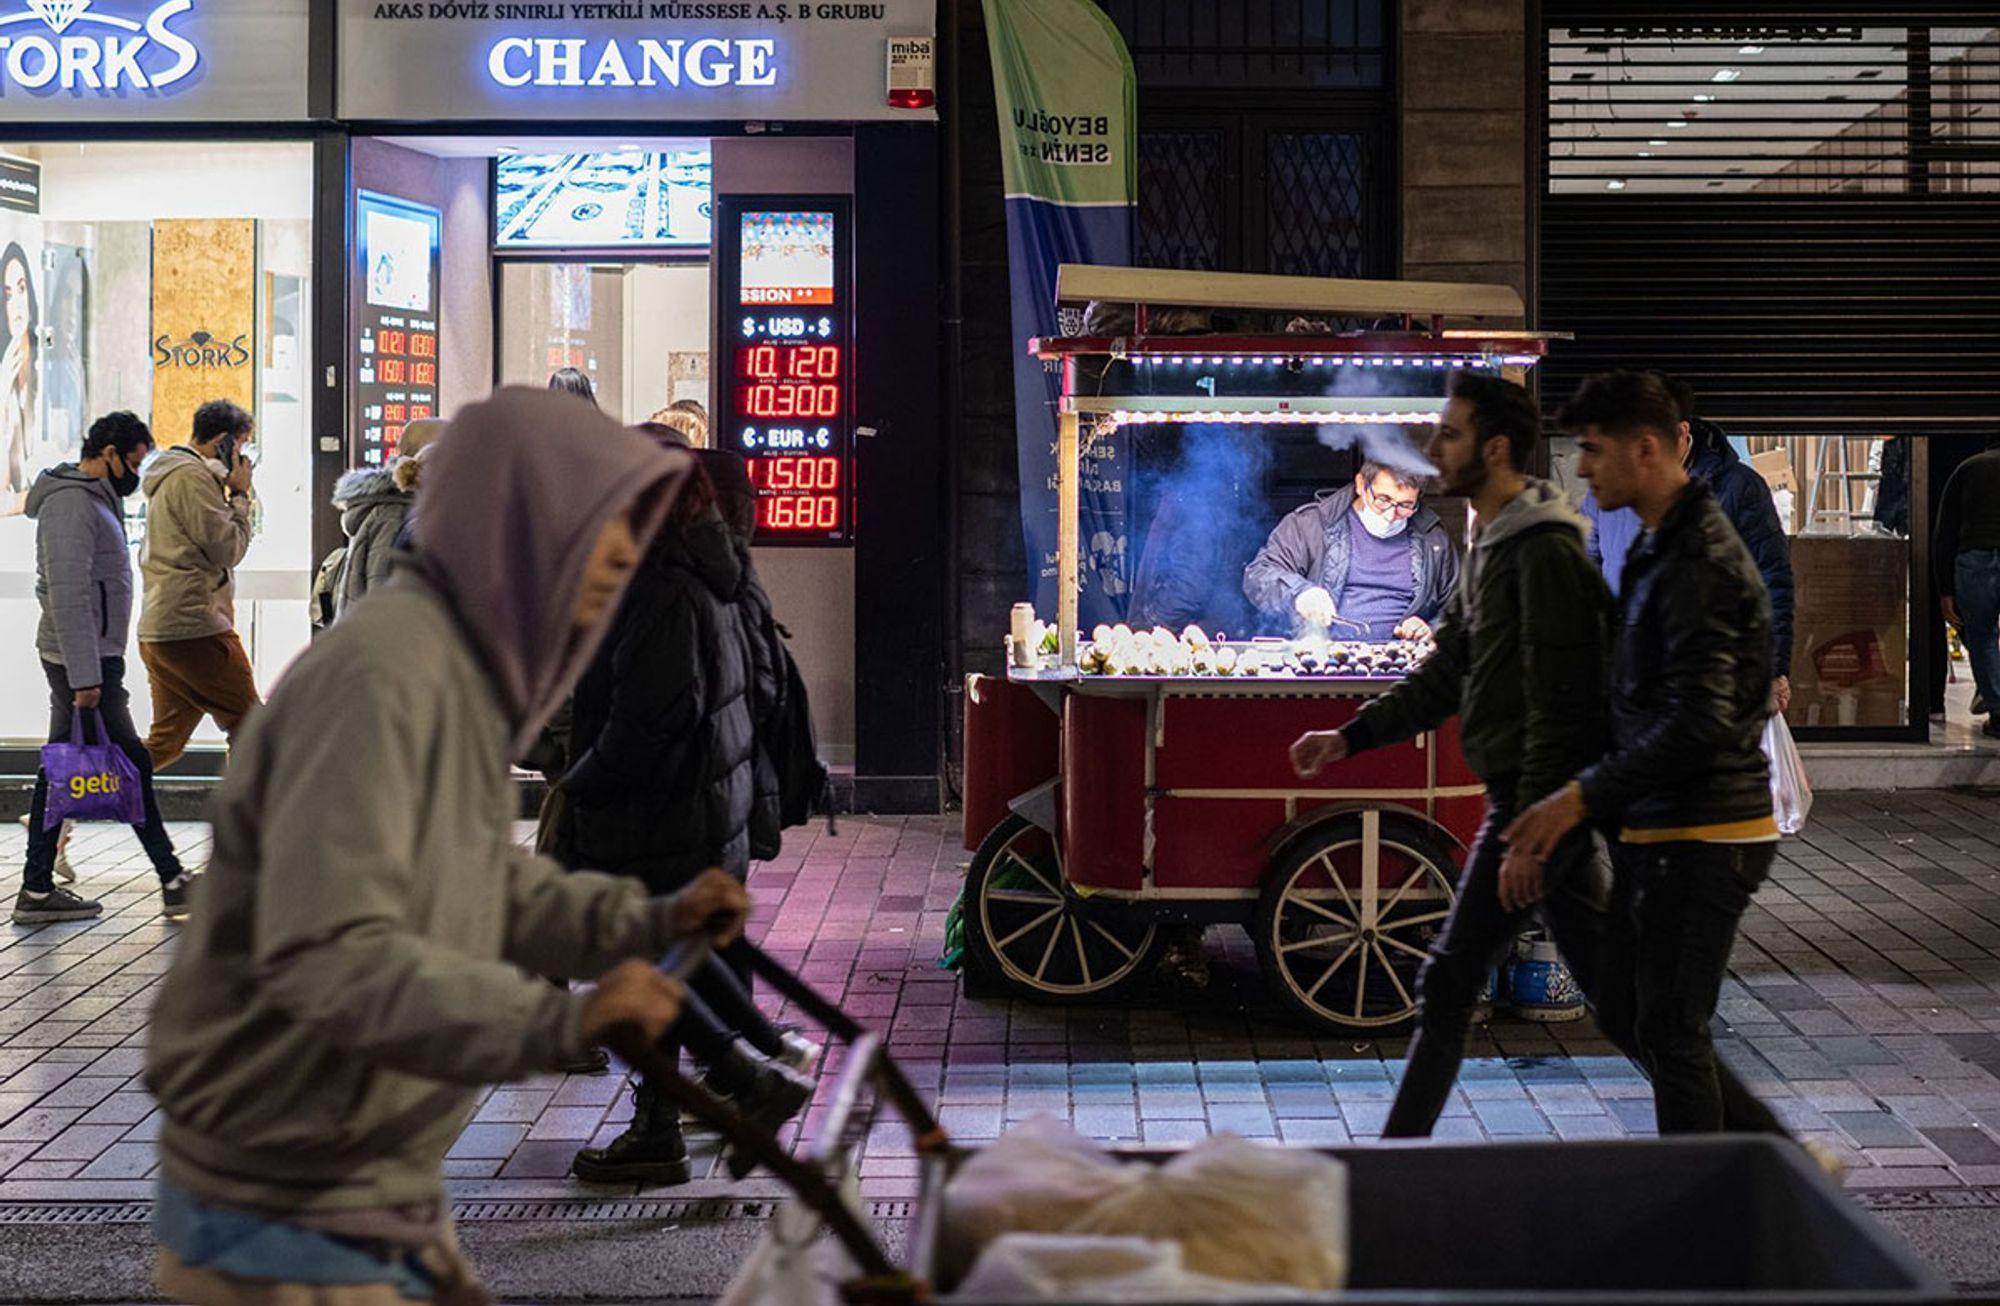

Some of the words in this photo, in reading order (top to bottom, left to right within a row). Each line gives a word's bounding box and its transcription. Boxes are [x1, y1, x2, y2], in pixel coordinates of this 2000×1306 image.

[373, 3, 424, 19] AKAS
[494, 3, 565, 19] SINIRLI
[570, 0, 644, 19] YETKİLİ
[650, 0, 752, 19] MÜESSESE
[756, 3, 792, 24] A.Ş.
[798, 3, 811, 19] B
[816, 3, 885, 20] GRUBU
[487, 37, 778, 87] CHANGE
[155, 334, 250, 367] STORKS
[746, 346, 839, 378] 10.120
[746, 384, 839, 417] 10.300
[766, 496, 839, 528] 1.680
